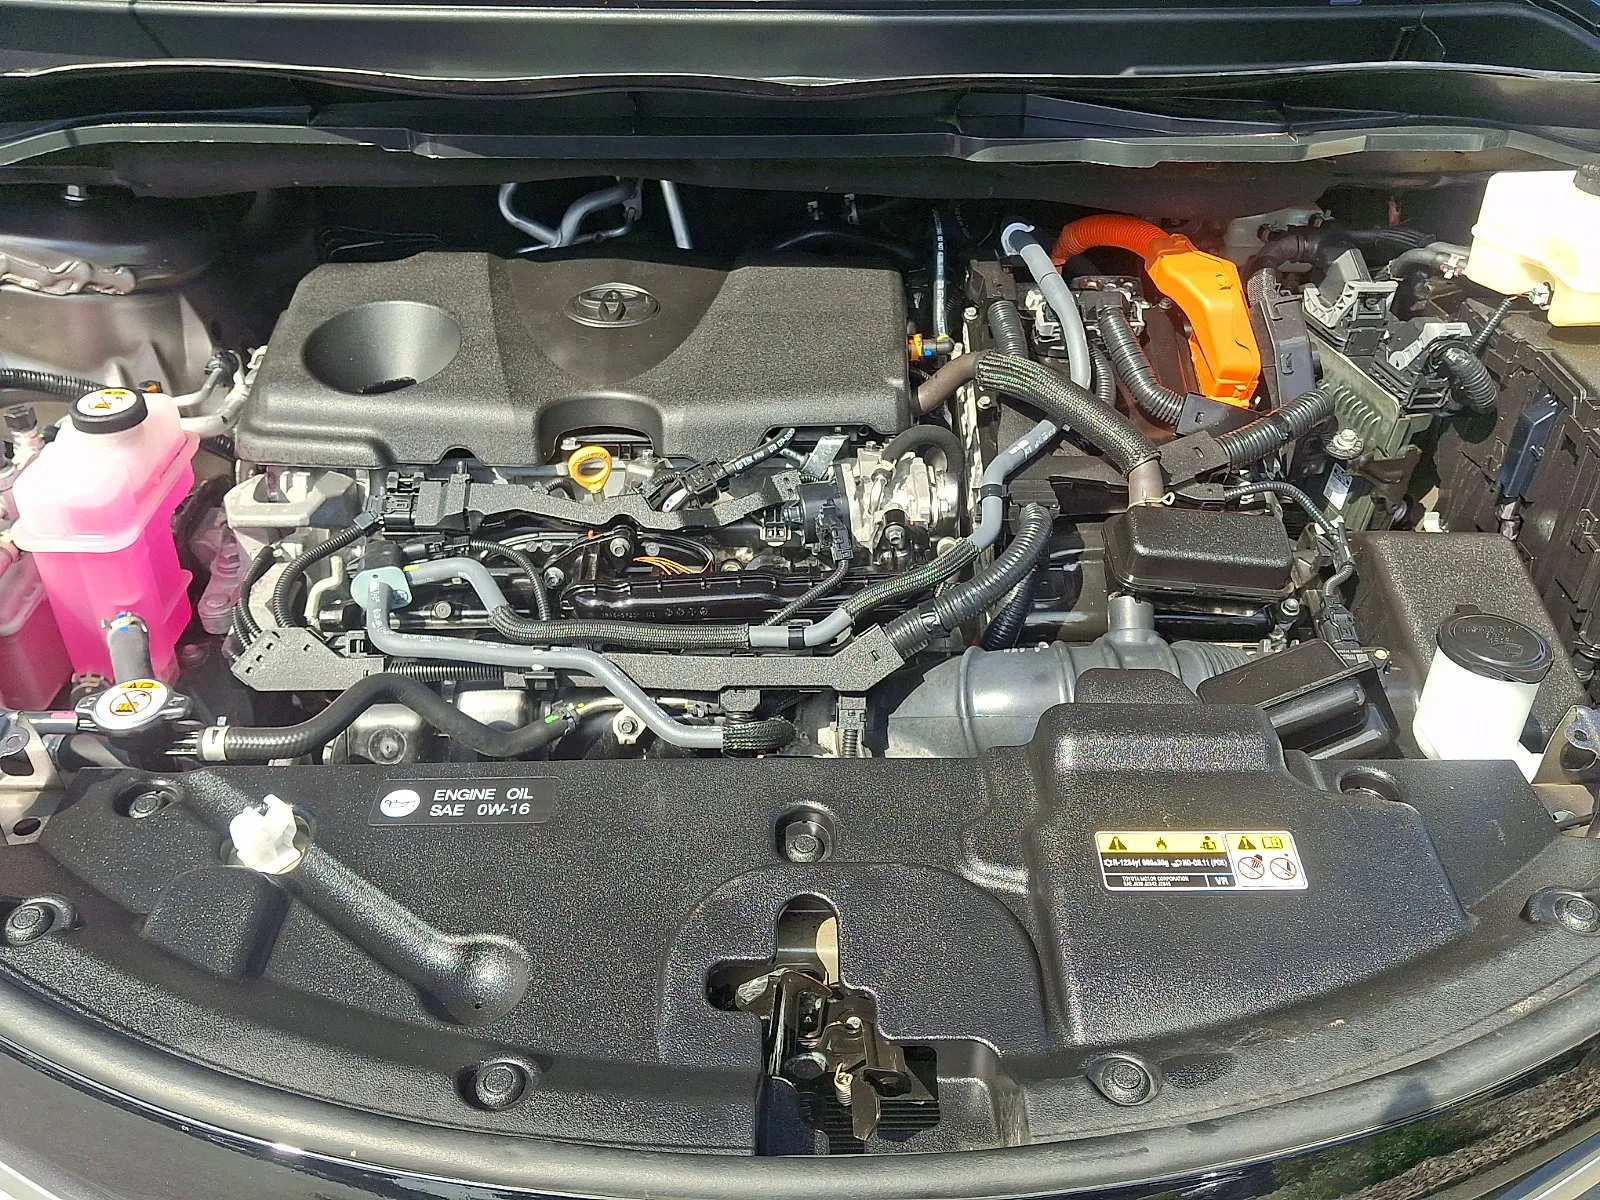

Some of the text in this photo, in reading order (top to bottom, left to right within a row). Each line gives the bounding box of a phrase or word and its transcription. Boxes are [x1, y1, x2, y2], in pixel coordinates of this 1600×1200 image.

[434, 787, 534, 801] ENGINE OIL
[429, 803, 531, 817] SAE 0W-16
[1214, 876, 1230, 886] VR
